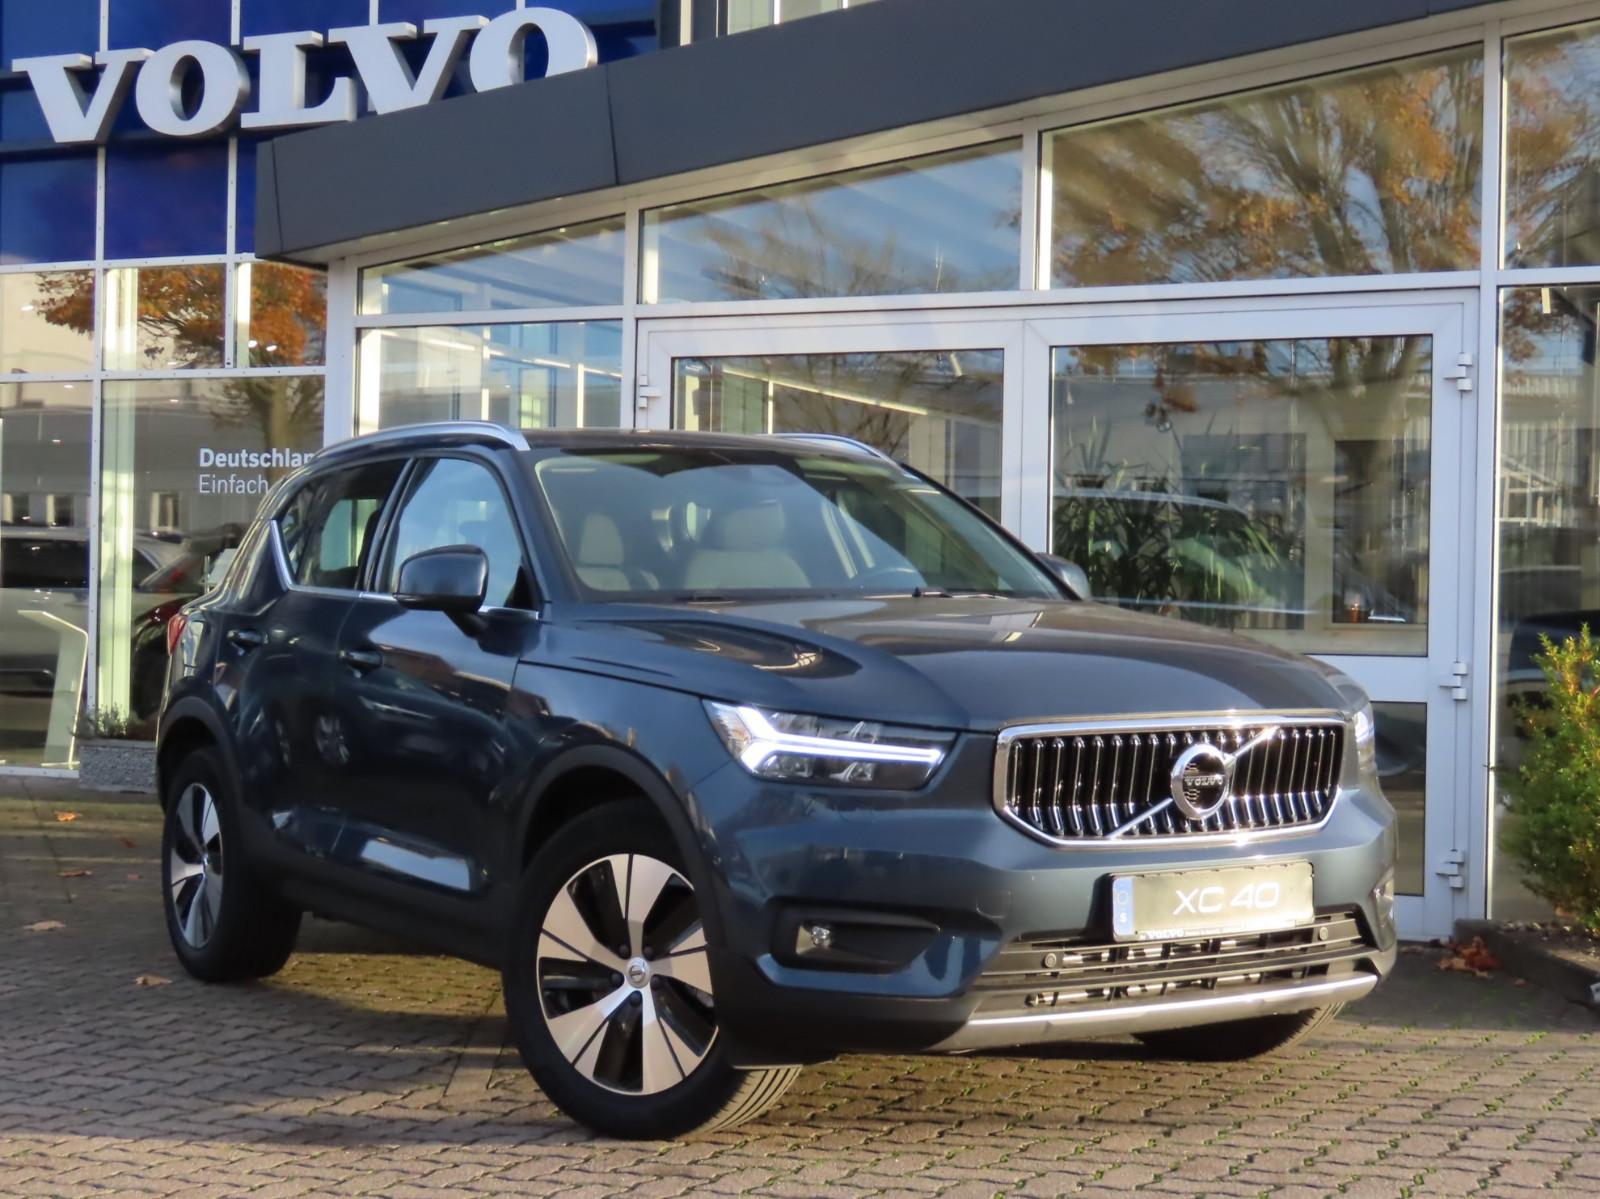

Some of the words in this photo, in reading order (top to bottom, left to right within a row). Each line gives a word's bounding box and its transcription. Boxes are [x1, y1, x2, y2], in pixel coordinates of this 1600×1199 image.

[12, 7, 598, 143] VOLVO
[199, 474, 269, 494] Einfach
[1184, 774, 1224, 786] VOLVO
[1173, 886, 1225, 916] XC
[1230, 882, 1281, 910] 40
[1119, 912, 1127, 923] S
